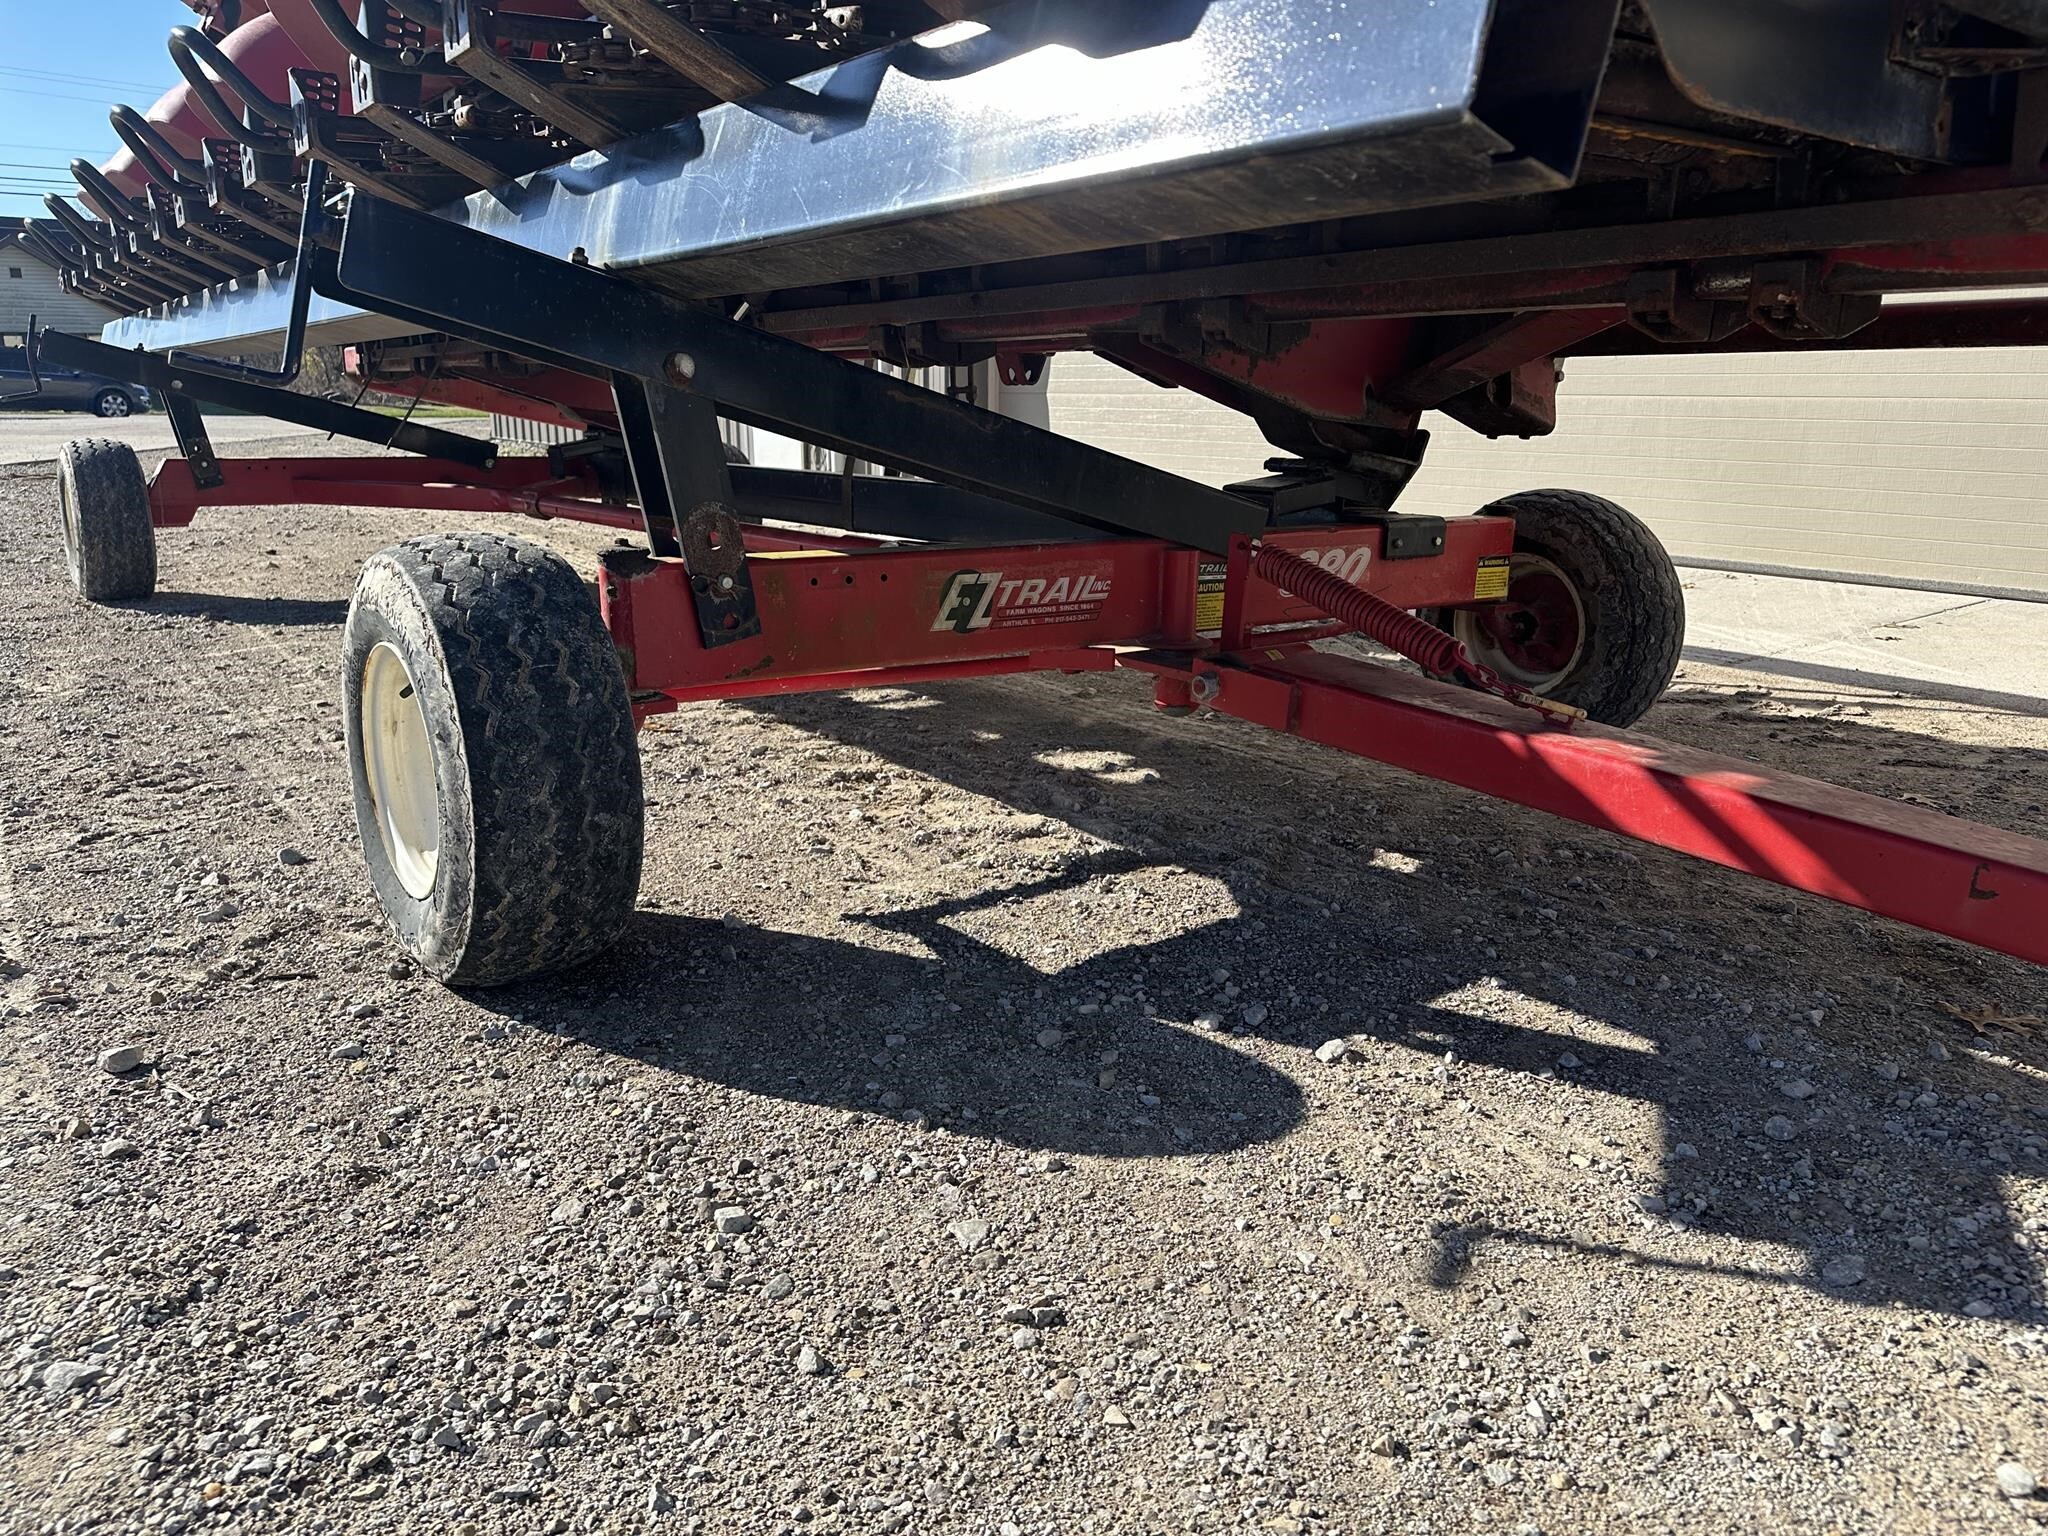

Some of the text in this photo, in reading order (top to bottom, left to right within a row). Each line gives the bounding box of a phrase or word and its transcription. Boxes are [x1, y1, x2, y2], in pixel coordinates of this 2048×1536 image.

[1199, 564, 1228, 573] TRAIL
[1197, 582, 1225, 592] AUTION
[929, 572, 1004, 632] EZ
[998, 576, 1109, 607] TRAIL
[1006, 608, 1026, 616] FARM
[1027, 605, 1057, 616] WAGONS
[1059, 603, 1079, 612] SINCE
